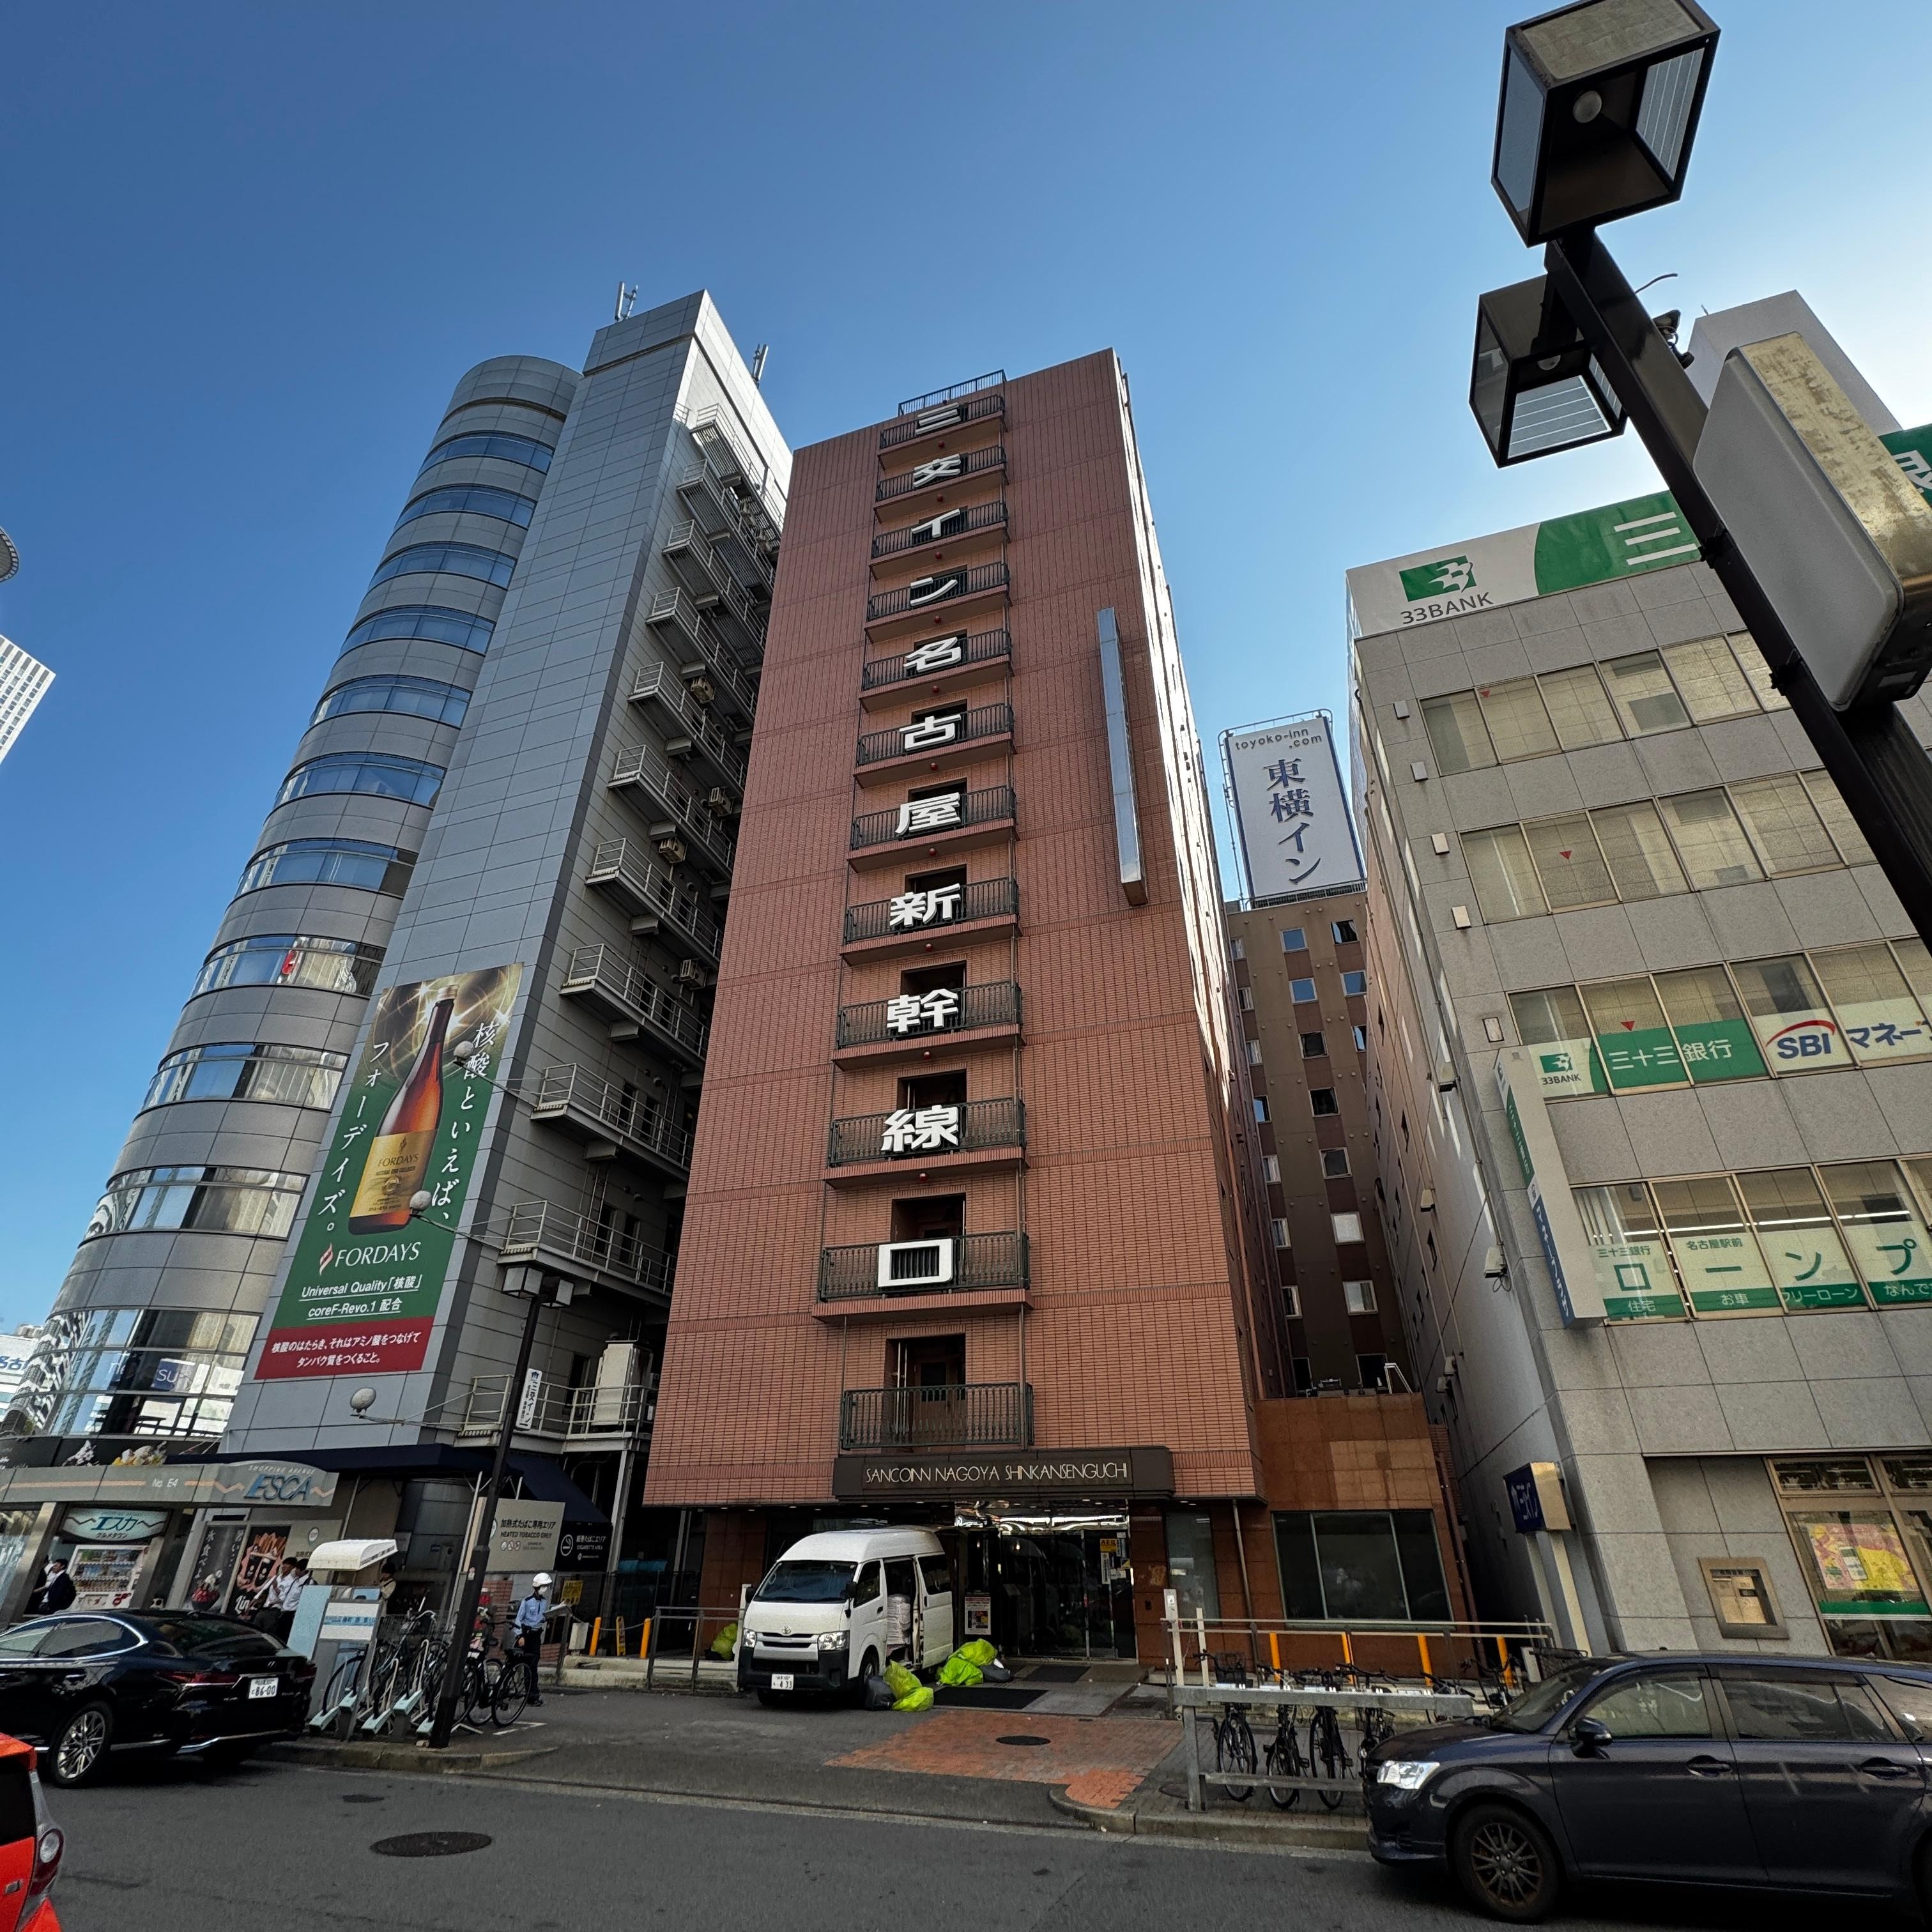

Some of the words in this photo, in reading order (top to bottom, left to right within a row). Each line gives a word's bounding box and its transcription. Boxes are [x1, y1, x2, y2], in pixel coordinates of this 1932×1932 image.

[1400, 592, 1494, 625] 33BANK
[1235, 728, 1308, 750] toyoko-inn
[1289, 734, 1322, 749] .com
[1263, 758, 1321, 885] 東横イン
[877, 402, 962, 1287] 三交イン名古屋新幹線口
[1608, 1039, 1733, 1070] 三十三銀行
[1777, 1032, 1832, 1060] SBI
[1541, 1073, 1582, 1085] 33BANK
[378, 1154, 420, 1167] FORDAYS
[334, 1241, 422, 1268] FORDAYS
[1597, 1245, 1651, 1258] 三十三銀行
[1686, 1238, 1744, 1251] 名古屋駅前
[301, 1282, 349, 1298] Universal
[1720, 1292, 1750, 1307] お車
[308, 1300, 377, 1317] coreF-Revo.1
[379, 1298, 402, 1312] 配合
[1629, 1299, 1657, 1313] 住宅
[167, 1477, 179, 1487] E4
[935, 1466, 1000, 1482] NAGOYA
[1005, 1462, 1128, 1480] SHINKANSENGUCHI
[243, 1473, 313, 1501] ESCA
[91, 1515, 139, 1531] エスカ
